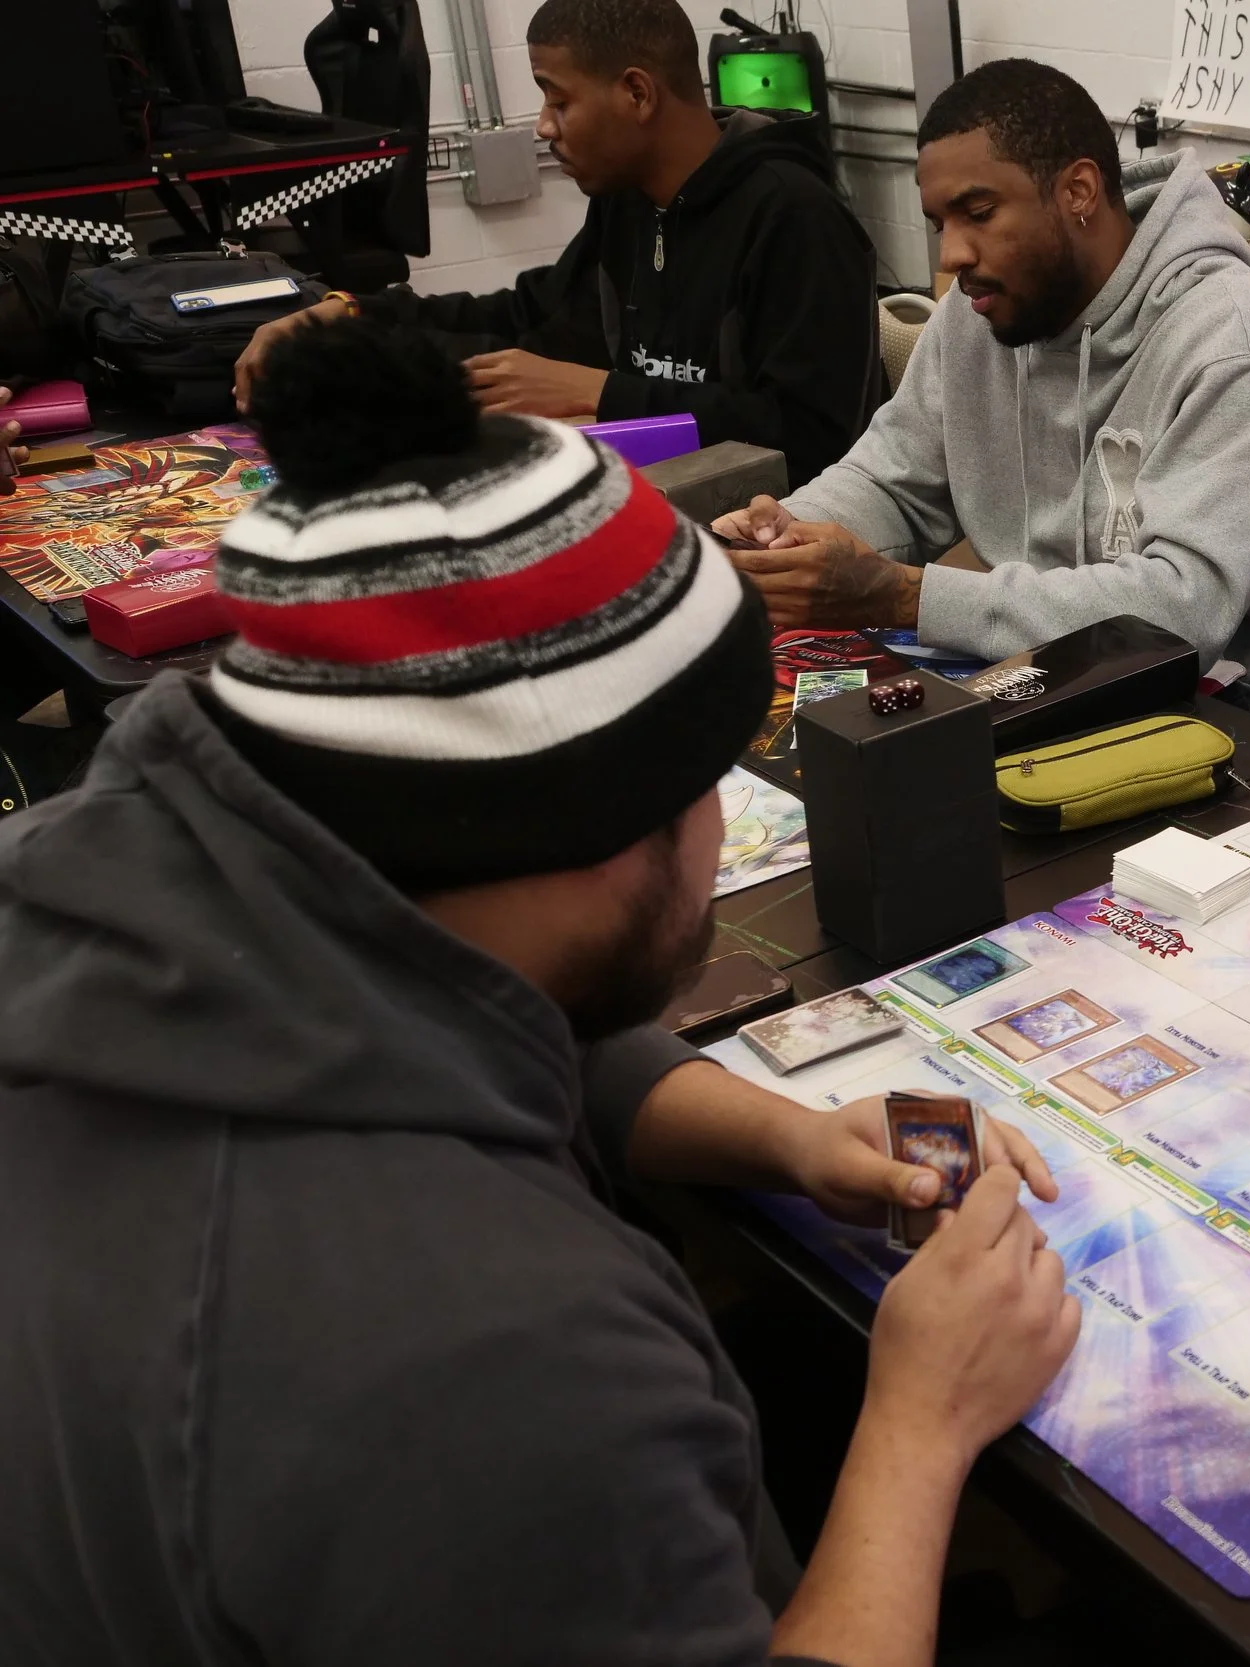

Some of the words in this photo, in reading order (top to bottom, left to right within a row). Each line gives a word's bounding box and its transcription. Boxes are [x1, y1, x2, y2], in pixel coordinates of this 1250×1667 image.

[1182, 8, 1248, 59] THIS
[1171, 63, 1243, 115] ASHY
[1034, 920, 1077, 946] KONAMI
